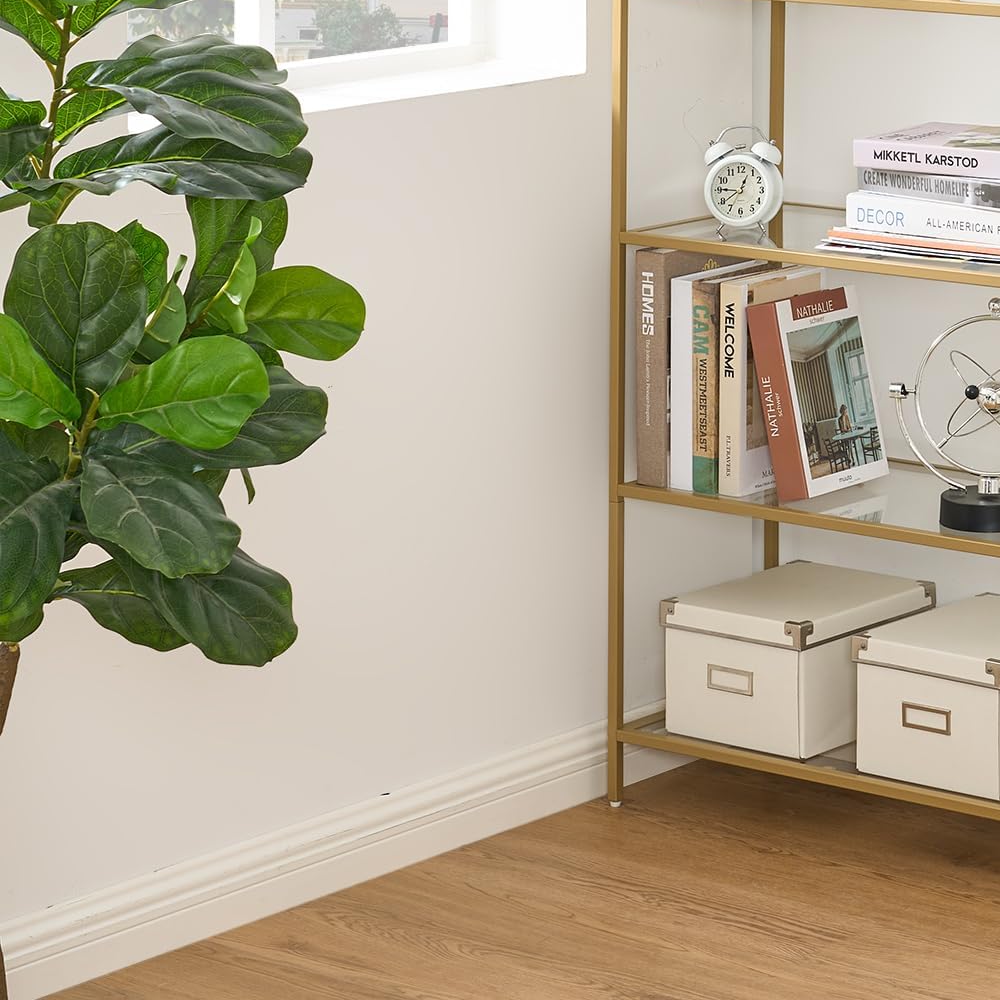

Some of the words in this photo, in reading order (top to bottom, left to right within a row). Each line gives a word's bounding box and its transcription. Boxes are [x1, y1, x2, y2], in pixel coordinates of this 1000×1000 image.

[873, 149, 921, 164] MIKKETL
[925, 154, 979, 169] KARSTOD
[751, 169, 755, 177] 1
[756, 176, 762, 184] 2
[863, 170, 888, 187] CREATE
[889, 174, 933, 193] WONDERFUL
[934, 179, 970, 198] HOMELIFE
[720, 197, 726, 205] 8
[727, 204, 733, 212] 7
[749, 204, 755, 212] 5
[756, 197, 761, 205] 4
[856, 207, 905, 227] DECOR
[926, 218, 993, 234] ALL-AMERICAN
[641, 271, 654, 336] HOMES
[796, 299, 834, 319] NATHALIE
[692, 305, 710, 355] CAM
[724, 302, 736, 378] WELCOME
[699, 358, 708, 452] WESTMEETSEAST
[761, 376, 780, 437] NATHALIE
[774, 392, 783, 417] schwer
